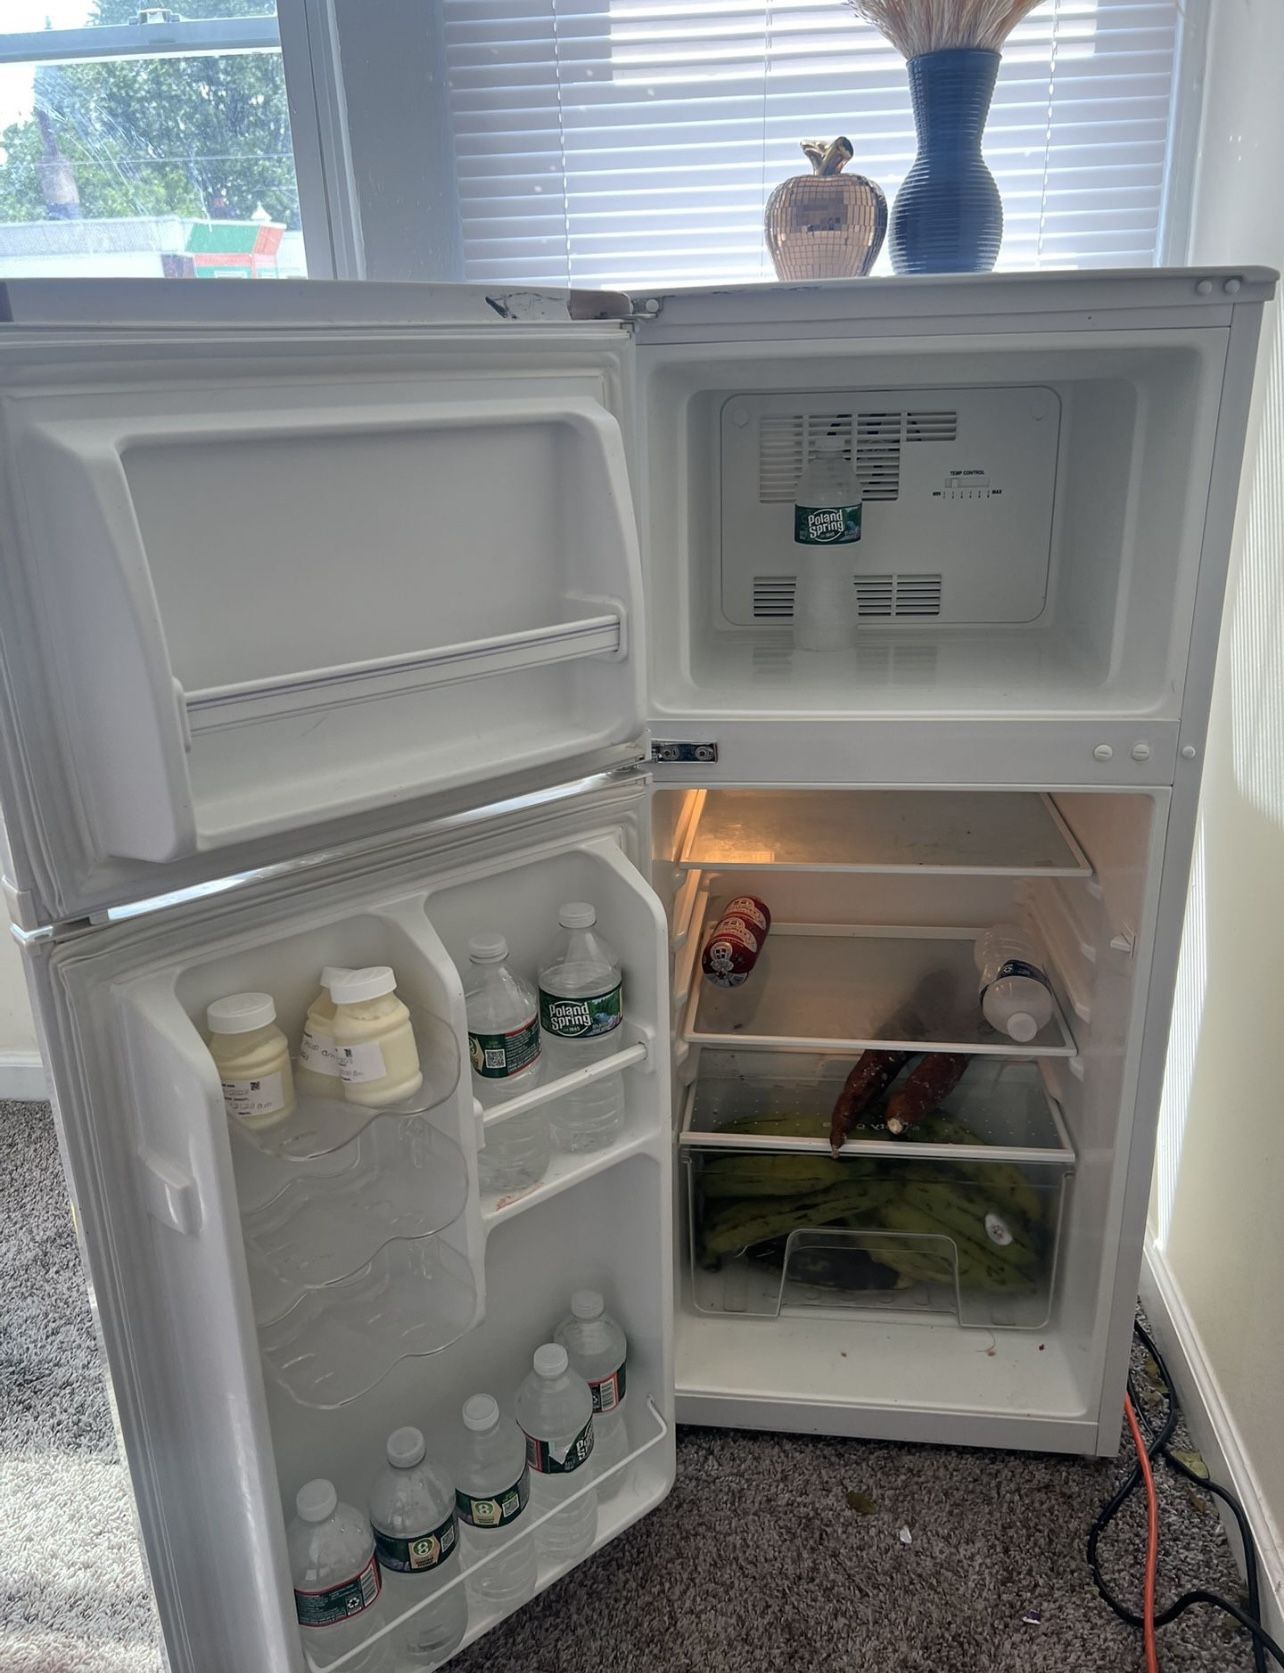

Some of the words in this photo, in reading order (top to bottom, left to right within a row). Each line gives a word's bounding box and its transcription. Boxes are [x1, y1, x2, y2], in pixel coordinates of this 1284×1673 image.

[808, 509, 843, 527] Poland
[809, 521, 844, 539] Spring
[549, 1002, 590, 1018] Poland
[550, 1015, 592, 1031] Spring
